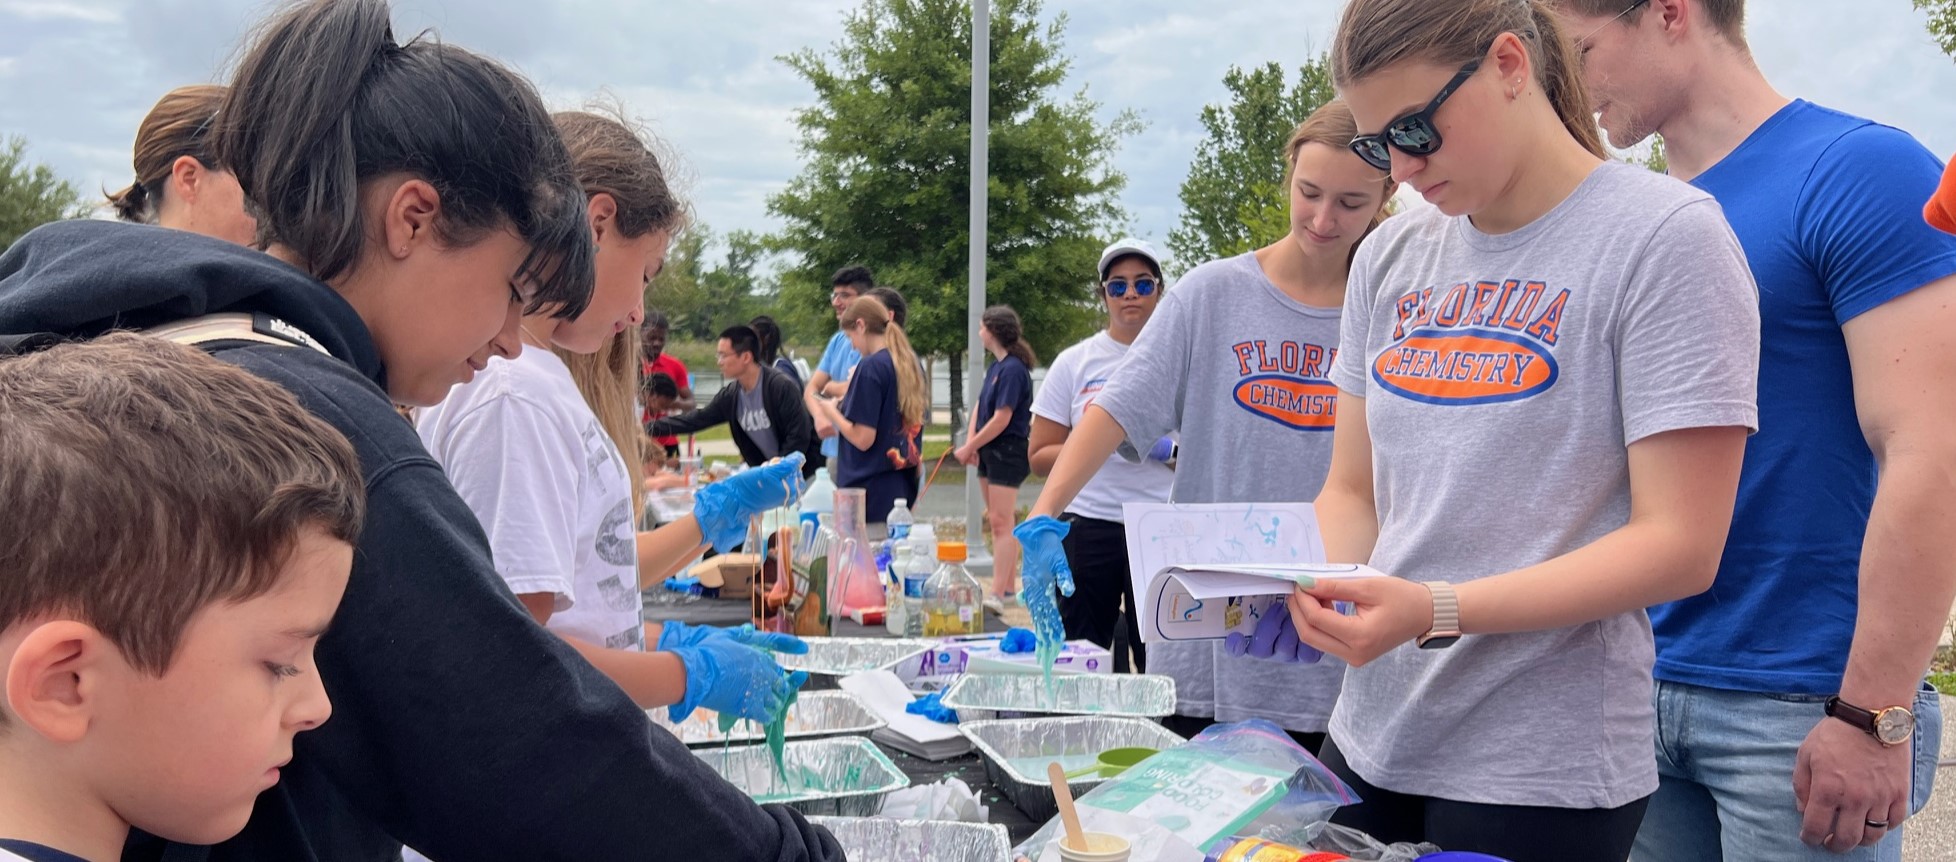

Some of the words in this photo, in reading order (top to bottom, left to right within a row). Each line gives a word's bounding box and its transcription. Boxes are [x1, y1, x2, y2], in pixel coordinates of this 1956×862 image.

[1393, 279, 1571, 347] FLORIDA
[1384, 347, 1534, 386] CHEMISTRY
[1143, 767, 1224, 801] COLORING
[1161, 788, 1210, 812] FOOD
